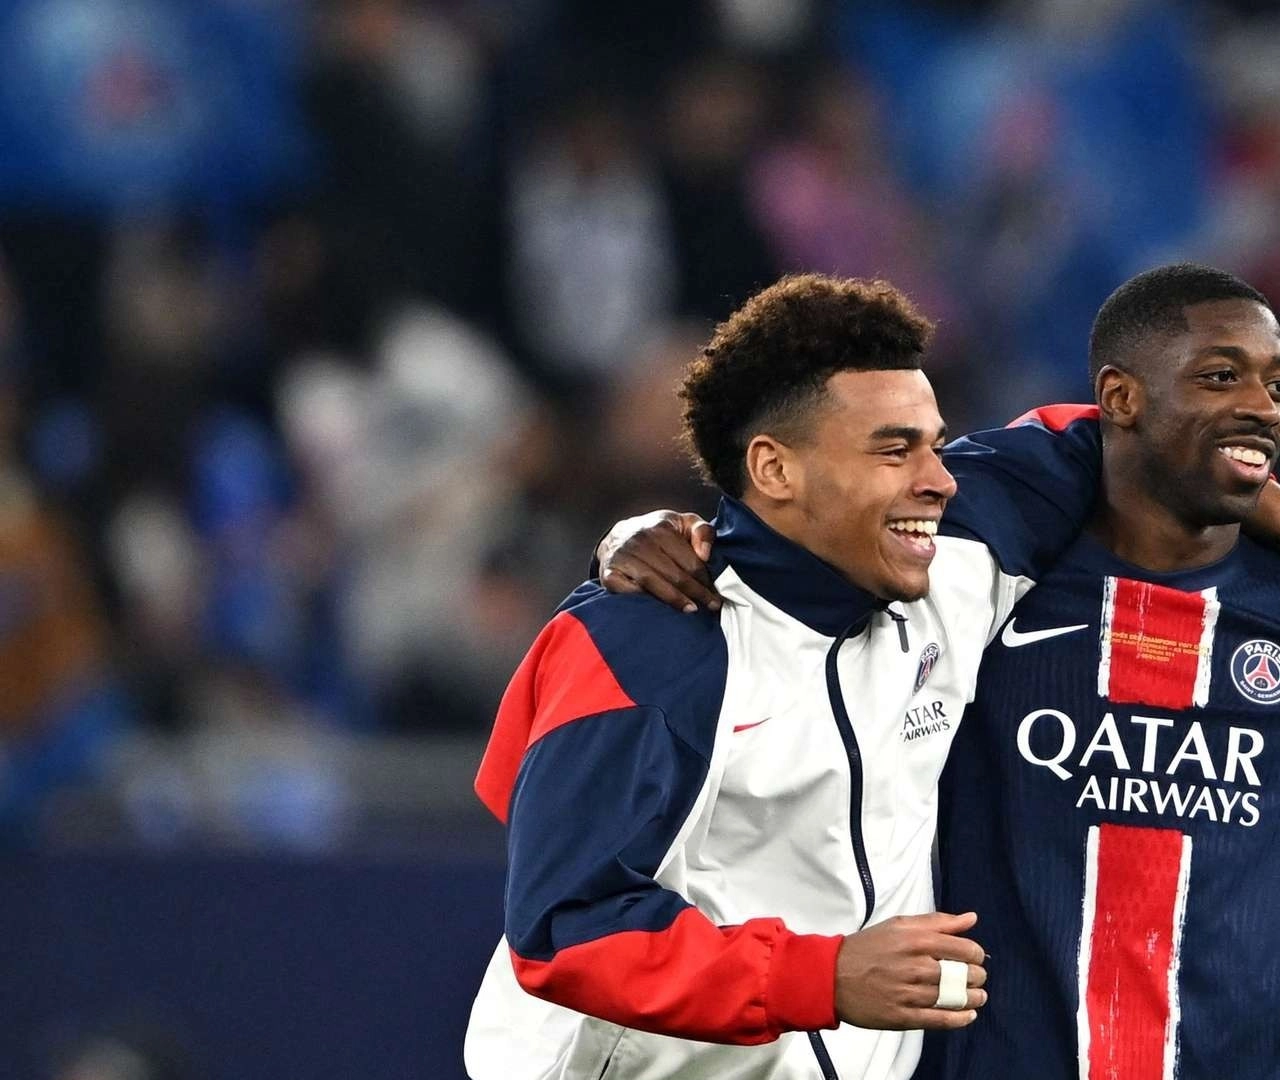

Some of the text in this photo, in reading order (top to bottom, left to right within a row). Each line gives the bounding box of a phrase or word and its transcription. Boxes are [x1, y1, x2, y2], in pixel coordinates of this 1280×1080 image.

[903, 701, 947, 730] ATAR
[903, 719, 951, 742] AIRWAYS
[1016, 708, 1266, 787] QATAR
[1076, 775, 1261, 828] AIRWAYS
